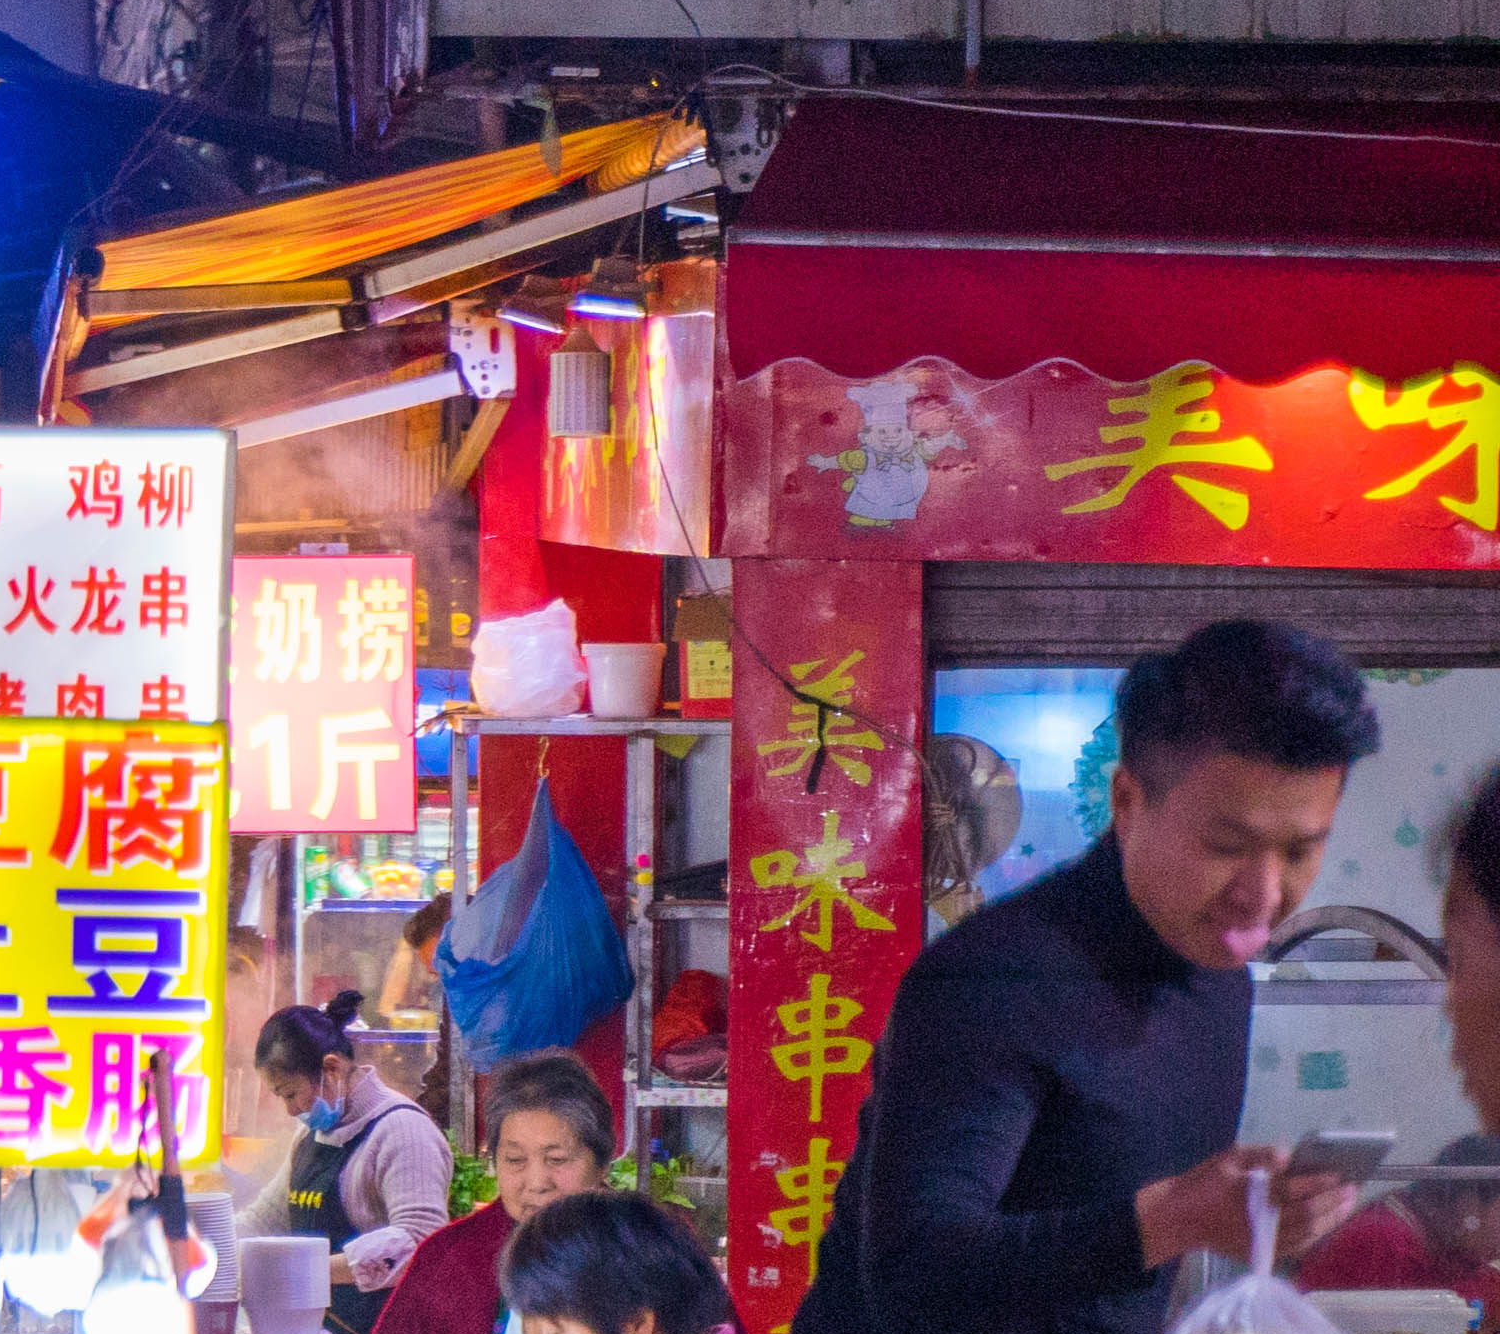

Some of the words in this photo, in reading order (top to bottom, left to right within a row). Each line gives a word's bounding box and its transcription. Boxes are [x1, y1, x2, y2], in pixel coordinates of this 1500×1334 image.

[66, 458, 193, 528] 鸡柳
[230, 578, 409, 683] 奶捞
[230, 708, 401, 820] 1斤
[749, 650, 898, 1334] 美味串串
